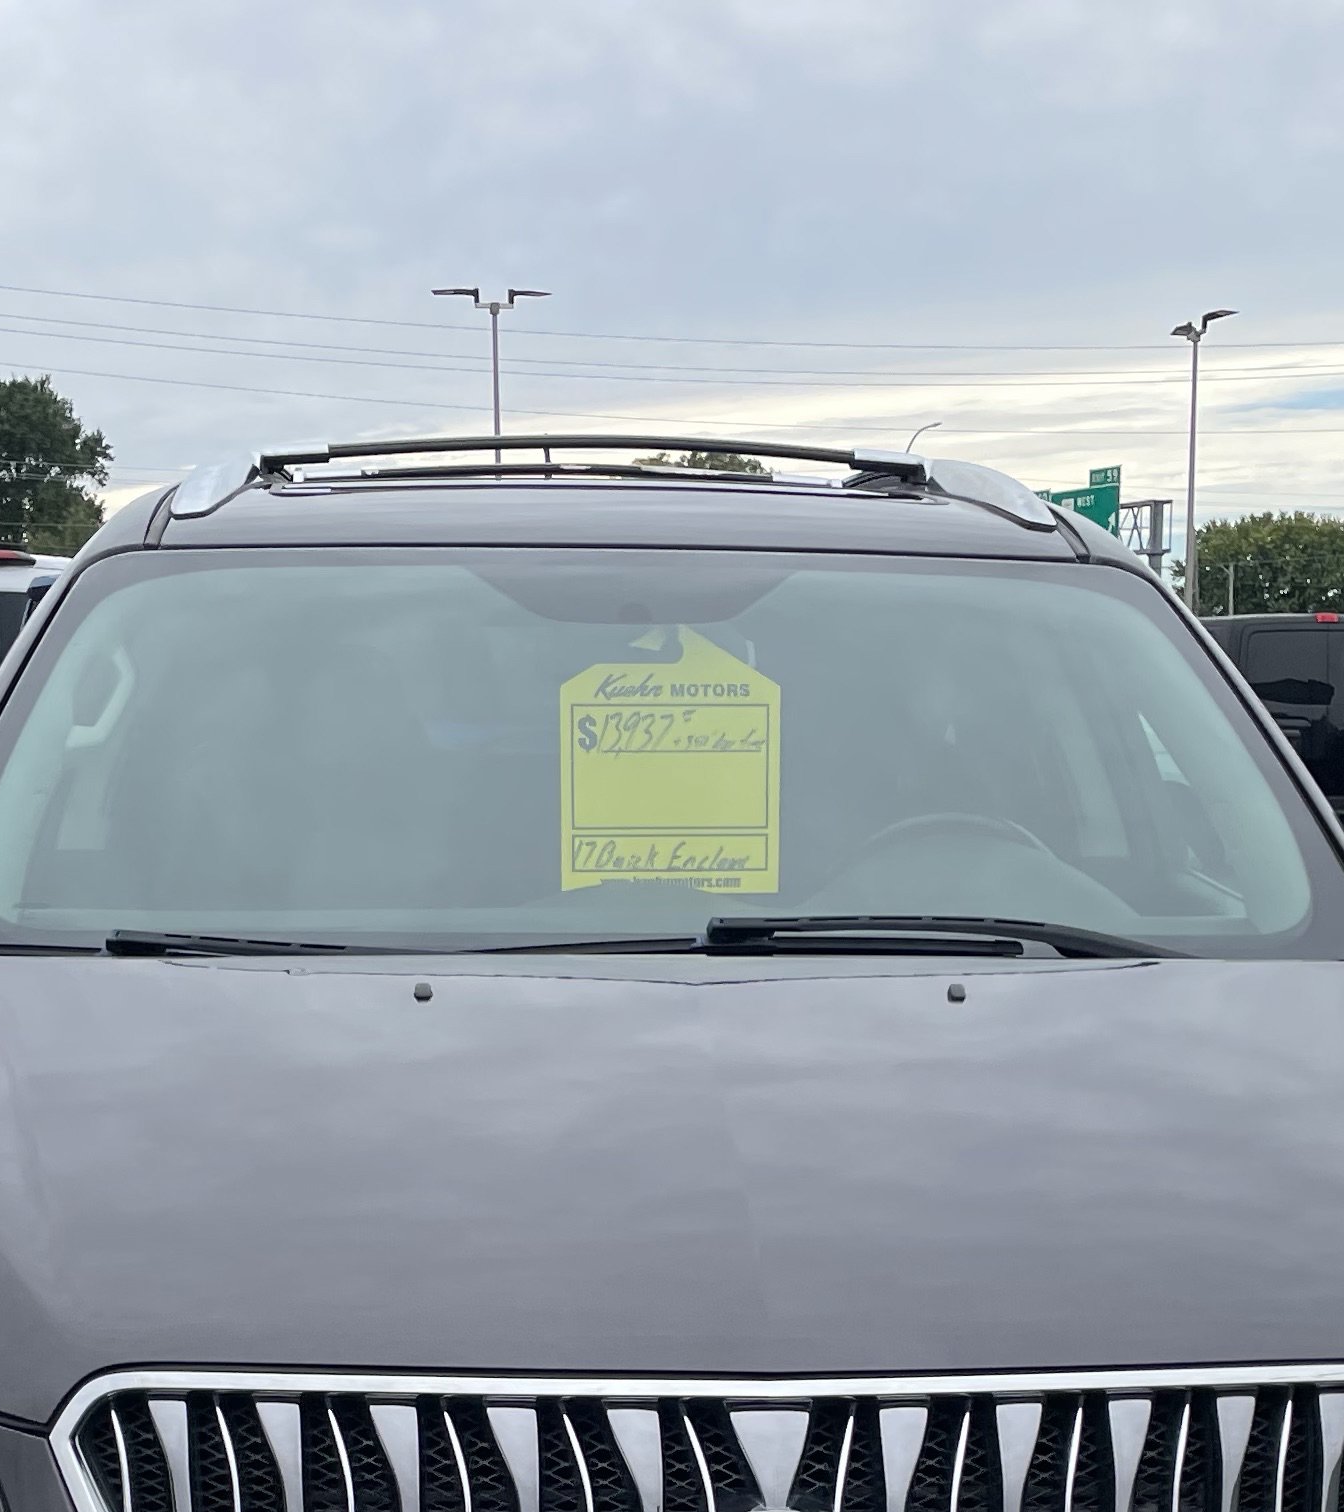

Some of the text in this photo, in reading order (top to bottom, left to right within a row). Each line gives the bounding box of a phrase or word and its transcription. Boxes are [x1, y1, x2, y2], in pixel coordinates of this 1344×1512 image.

[1077, 494, 1095, 508] WEST
[594, 673, 750, 700] Kuehn MOTORS
